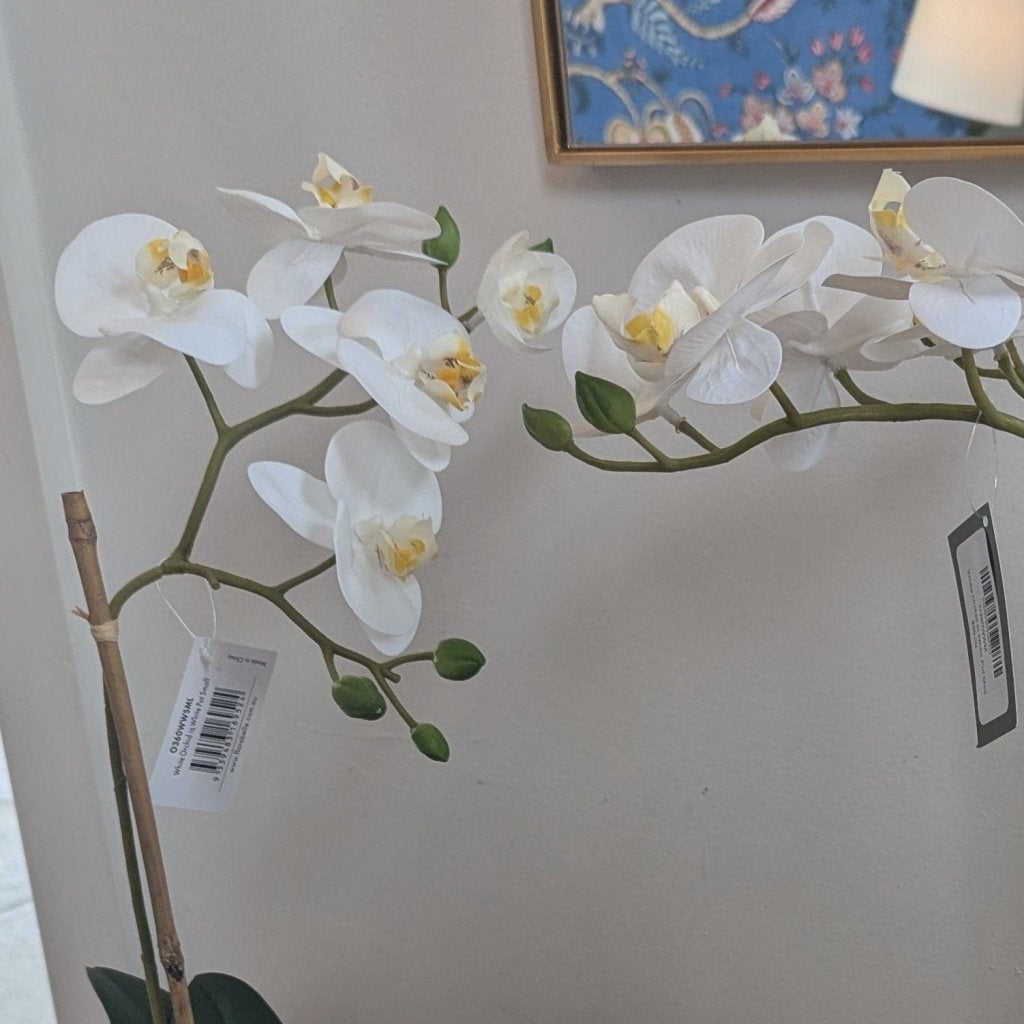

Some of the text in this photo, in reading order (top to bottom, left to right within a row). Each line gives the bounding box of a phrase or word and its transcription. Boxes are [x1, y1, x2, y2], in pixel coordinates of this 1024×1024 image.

[173, 758, 185, 776] White
[190, 706, 202, 727] White
[199, 678, 211, 696] Small
